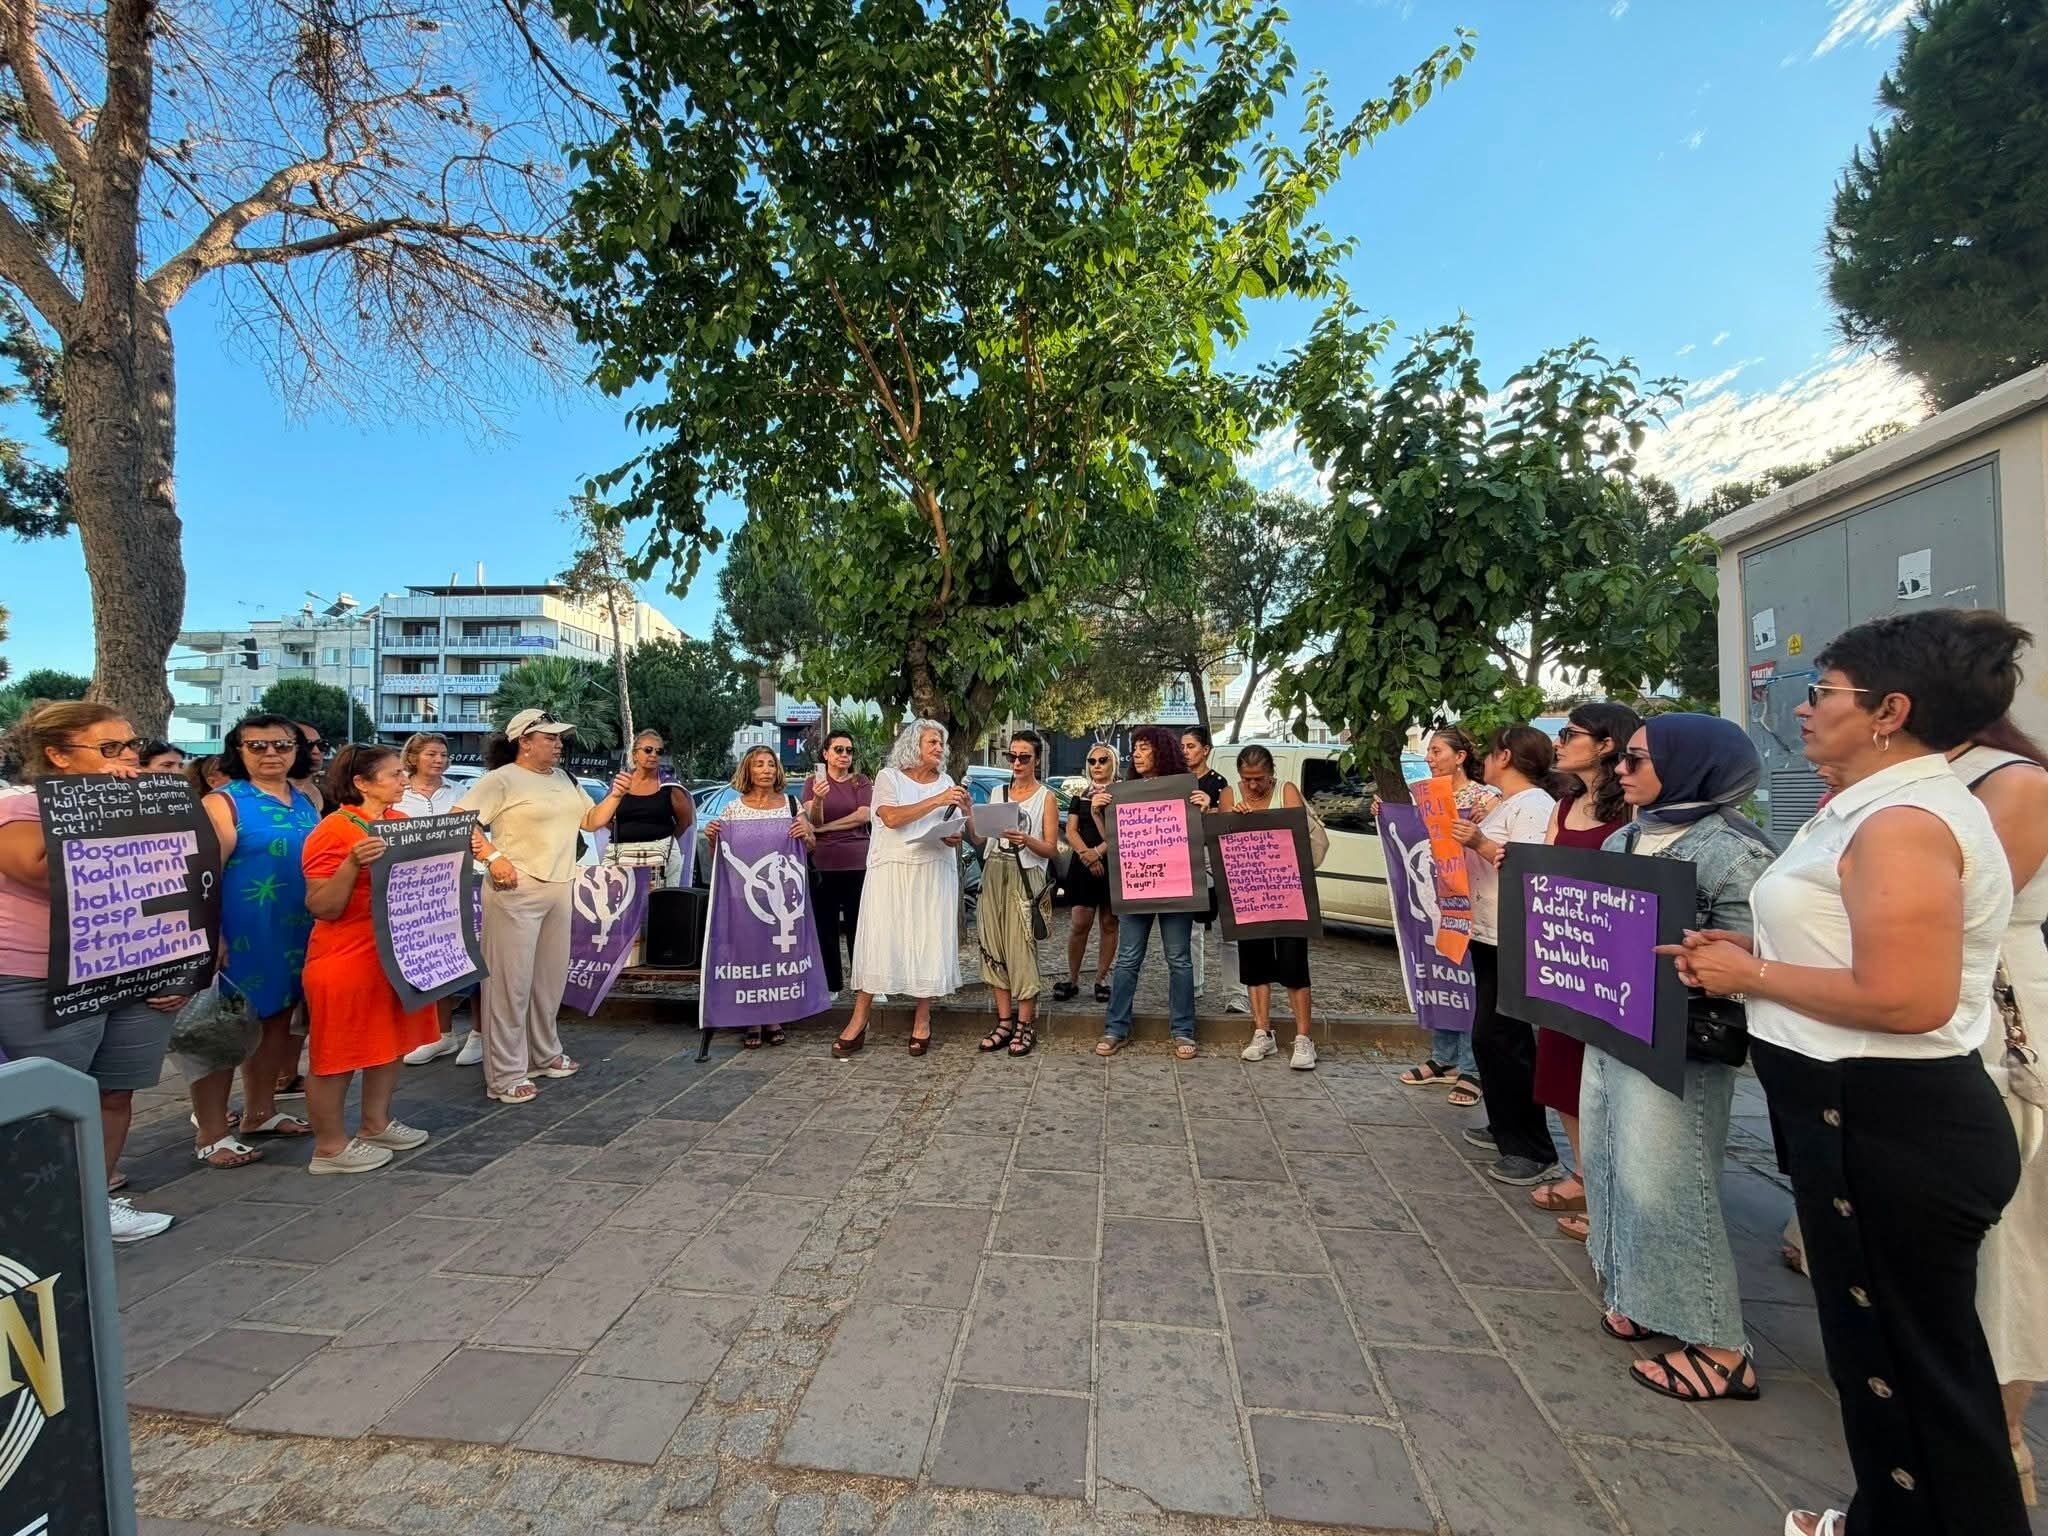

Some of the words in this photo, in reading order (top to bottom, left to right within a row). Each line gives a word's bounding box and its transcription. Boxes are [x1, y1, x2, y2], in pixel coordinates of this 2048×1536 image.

[45, 777, 131, 796] Torbadan
[50, 804, 133, 823] kadınlara
[139, 802, 163, 816] hak
[1119, 813, 1177, 827] maddelerin
[374, 818, 434, 834] TORBADAN
[1119, 826, 1153, 839] hepsi
[1155, 823, 1182, 835] halk
[67, 836, 188, 862] Boşanmayı
[401, 833, 422, 846] HAK
[389, 871, 451, 893] nafakanın
[390, 865, 418, 879] Esas
[74, 877, 187, 912] haklarını
[387, 886, 425, 905] süresi
[1261, 891, 1285, 902] ilan
[1530, 875, 1552, 893] 12.
[1553, 885, 1588, 906] yargı
[388, 896, 447, 918] kadınların
[1235, 902, 1289, 913] edilemez.
[72, 906, 137, 937] gasp
[390, 908, 459, 934] boşandıktan
[1541, 918, 1595, 945] yoksa
[73, 918, 187, 953] etmeden
[392, 930, 425, 945] sonra
[75, 933, 202, 978] hızlandırın
[1534, 939, 1609, 973] hukukun
[403, 960, 443, 980] nafaka
[715, 962, 772, 980] KİBELE
[1431, 963, 1477, 988] KADI
[53, 981, 109, 1006] medeni
[735, 980, 805, 1004] DERNEĞİ
[1594, 981, 1632, 1017] mu?
